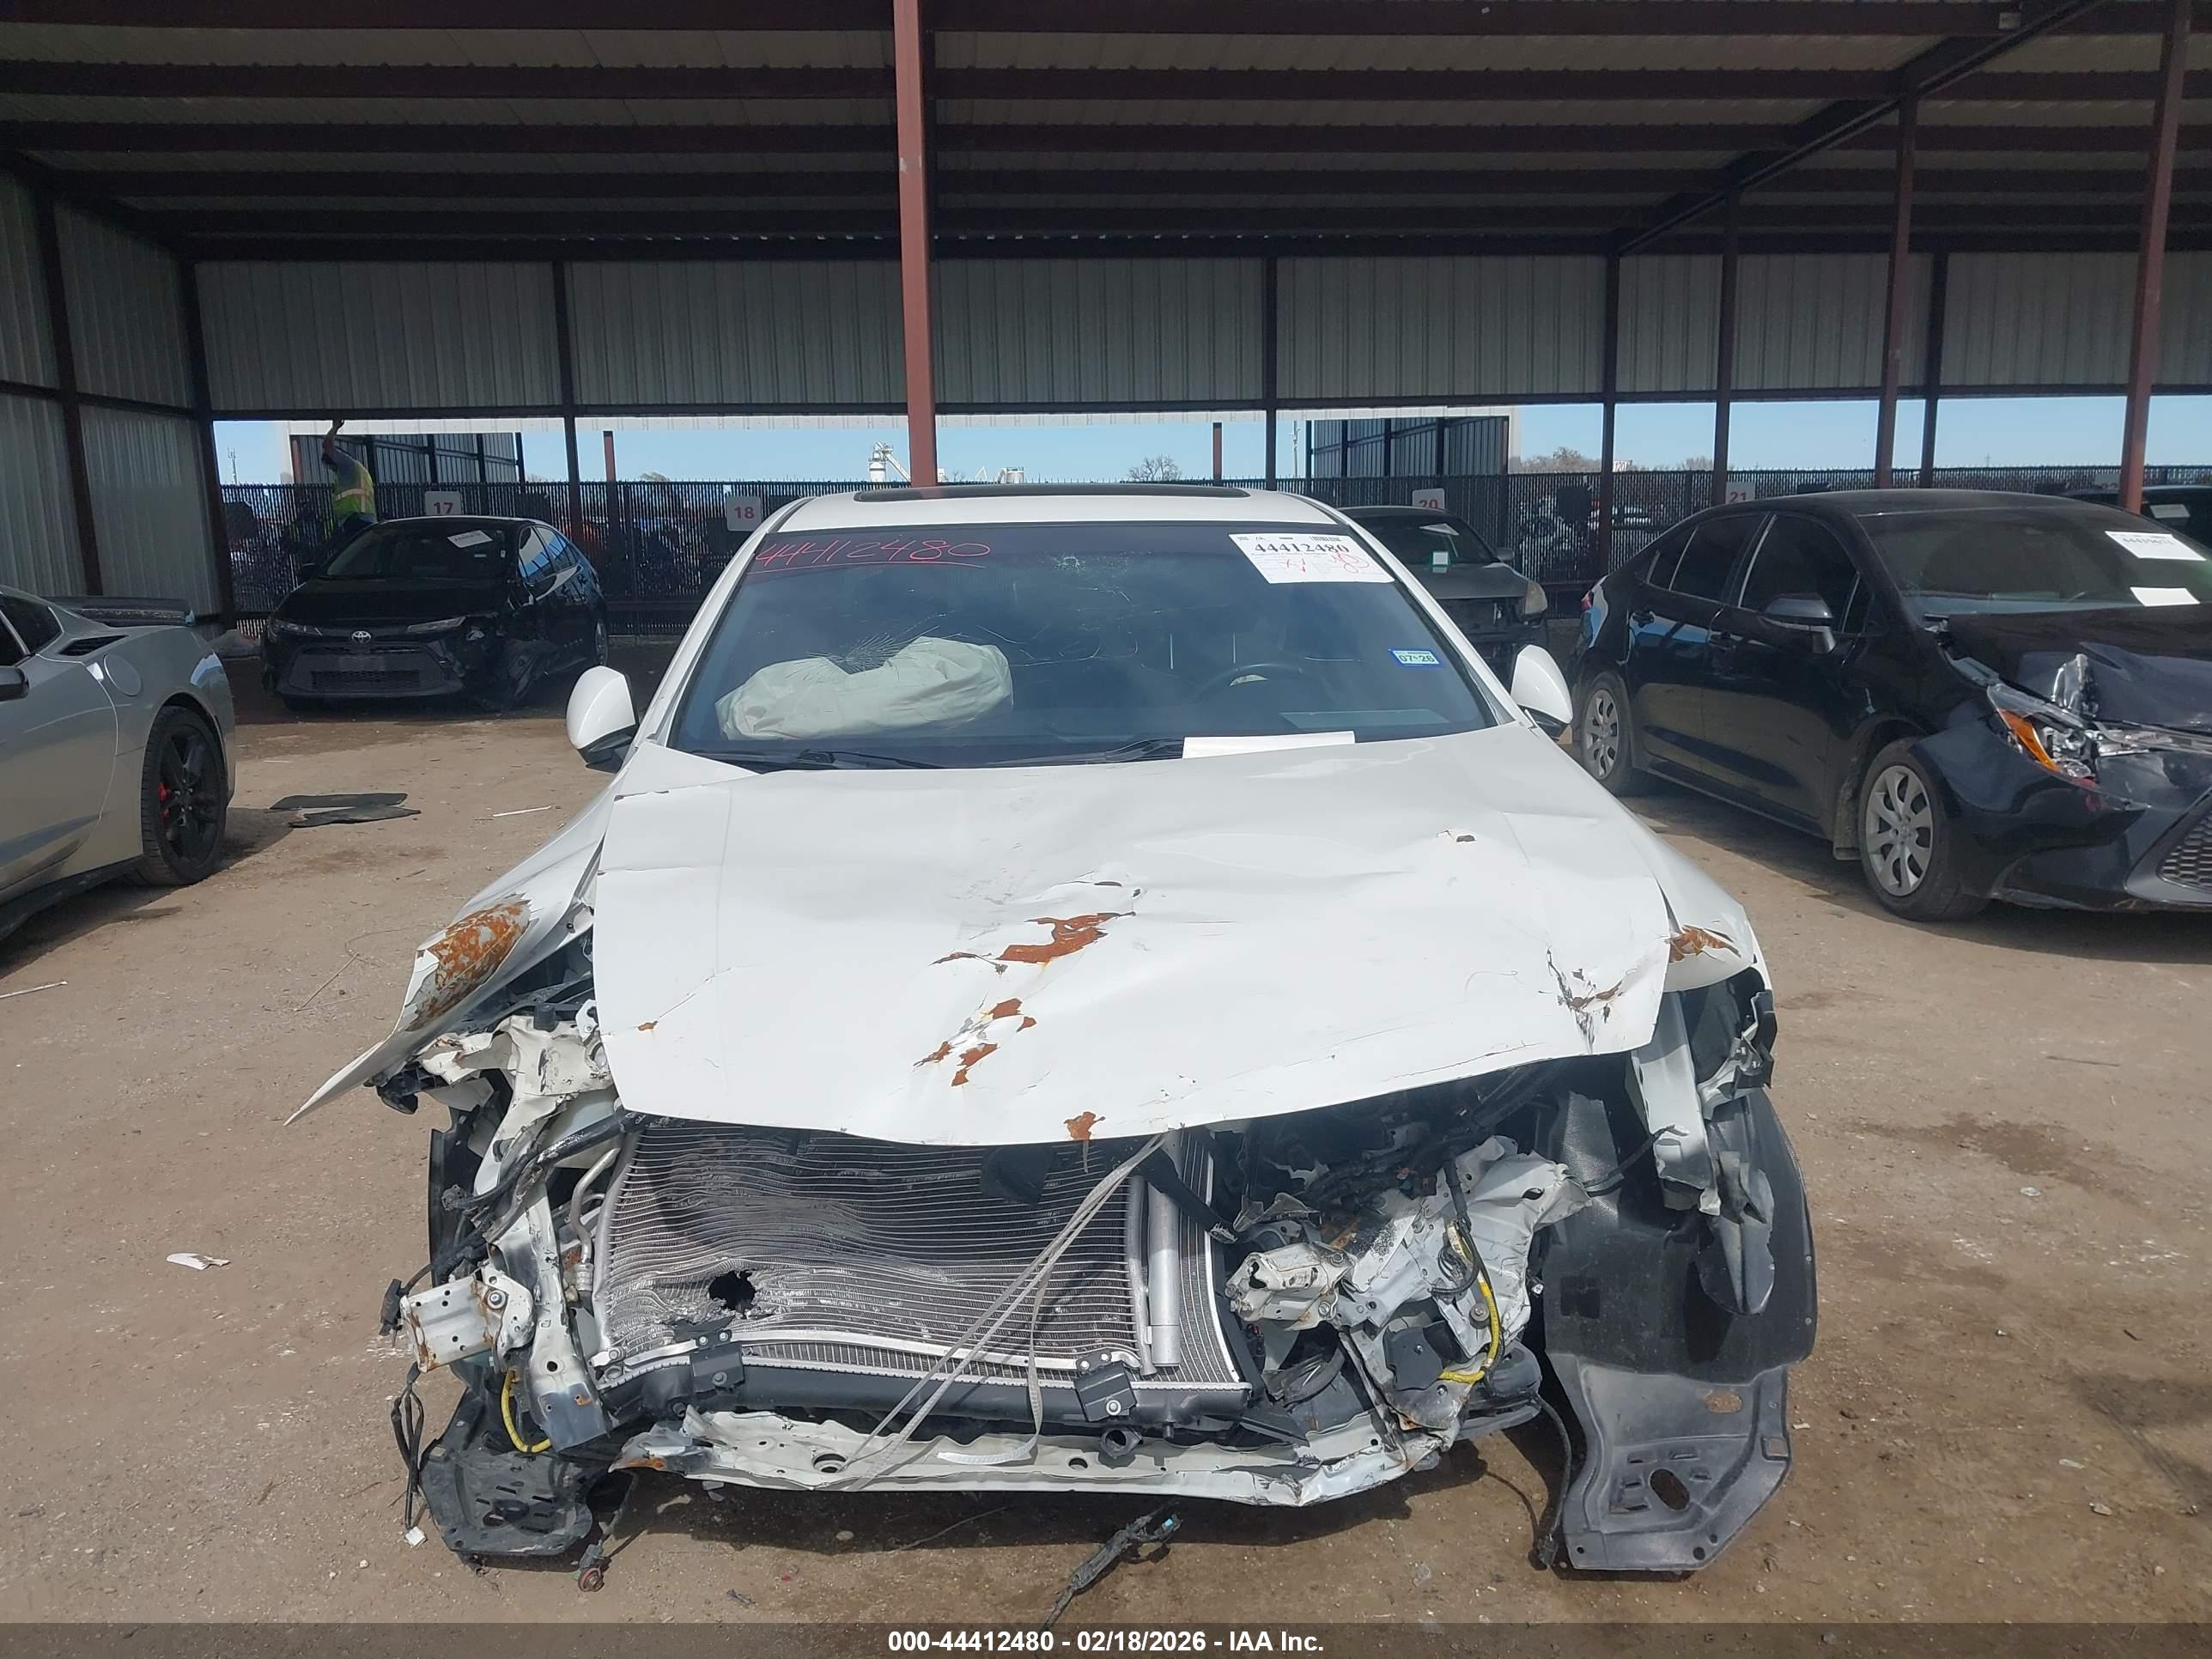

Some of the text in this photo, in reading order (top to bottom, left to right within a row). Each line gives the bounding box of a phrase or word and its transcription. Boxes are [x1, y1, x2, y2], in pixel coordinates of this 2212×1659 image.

[1729, 491, 1747, 503] 21
[433, 501, 454, 514] 17
[734, 507, 755, 519] 18
[754, 538, 991, 567] 44412480
[1254, 543, 1350, 553] 44412480
